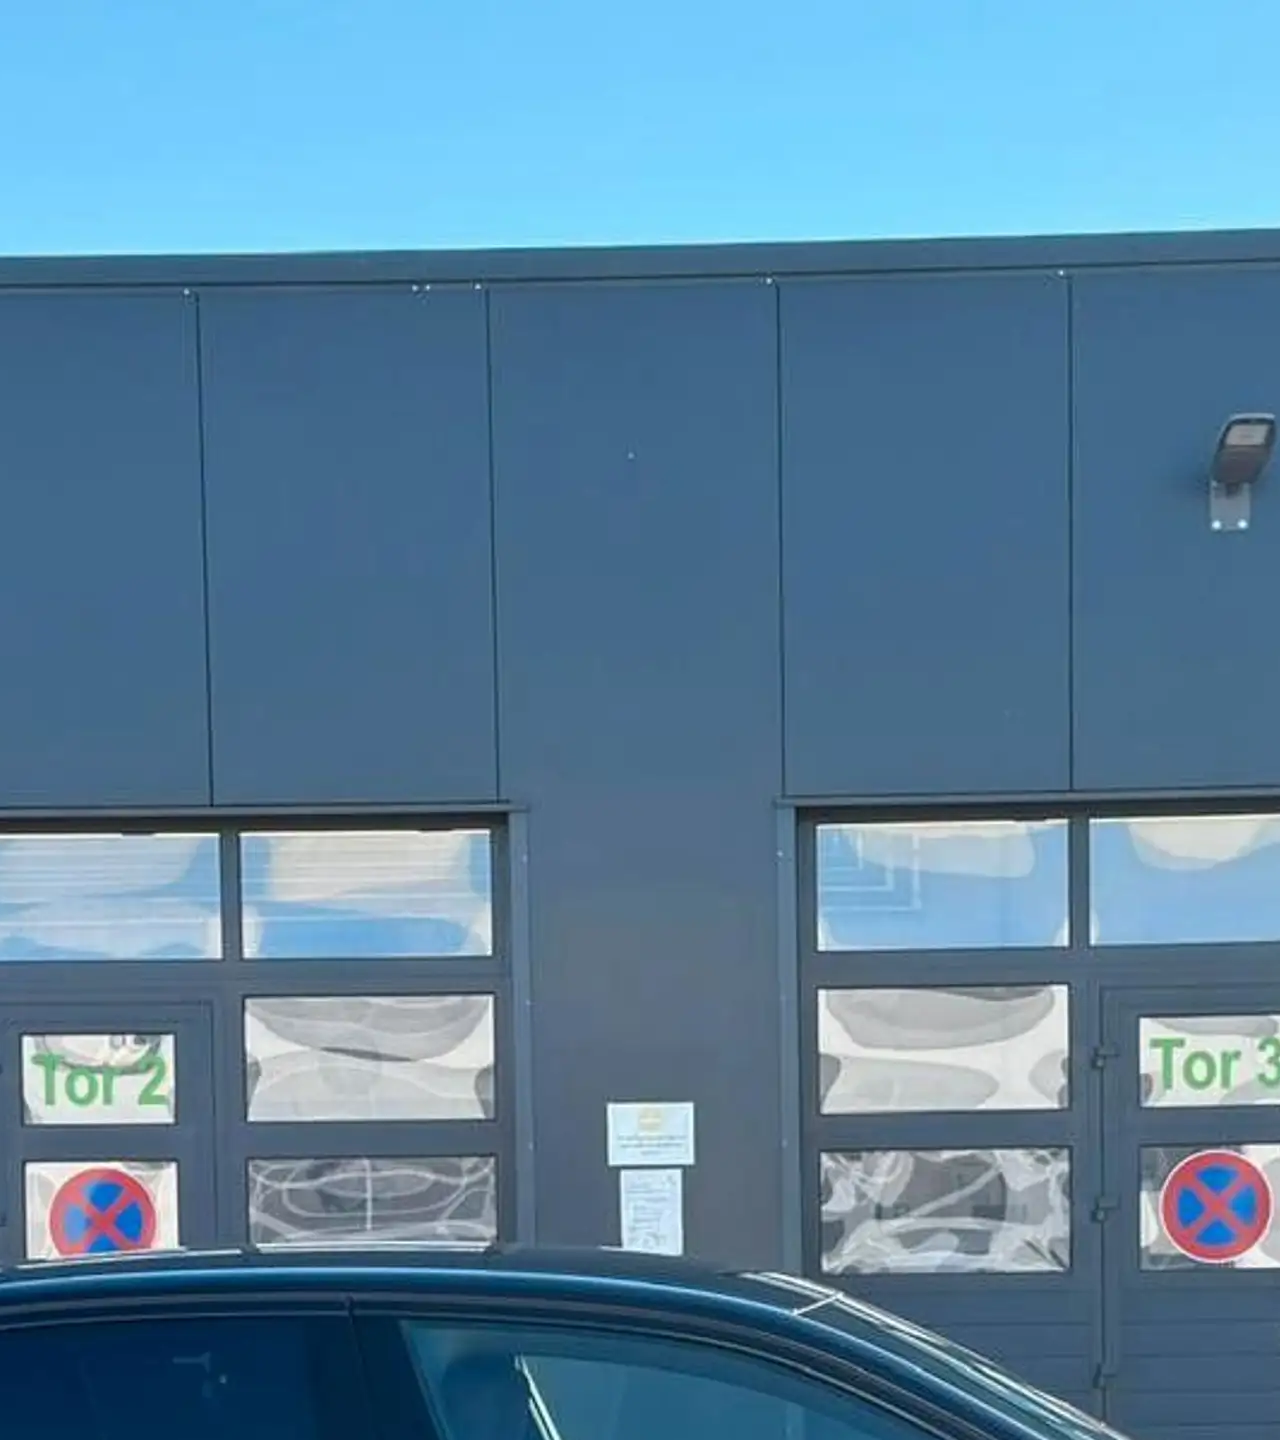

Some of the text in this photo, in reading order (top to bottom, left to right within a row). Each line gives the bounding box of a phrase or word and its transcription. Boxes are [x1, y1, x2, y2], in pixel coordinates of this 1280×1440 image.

[31, 1054, 168, 1107] Tor 2
[1149, 1037, 1242, 1090] Tor
